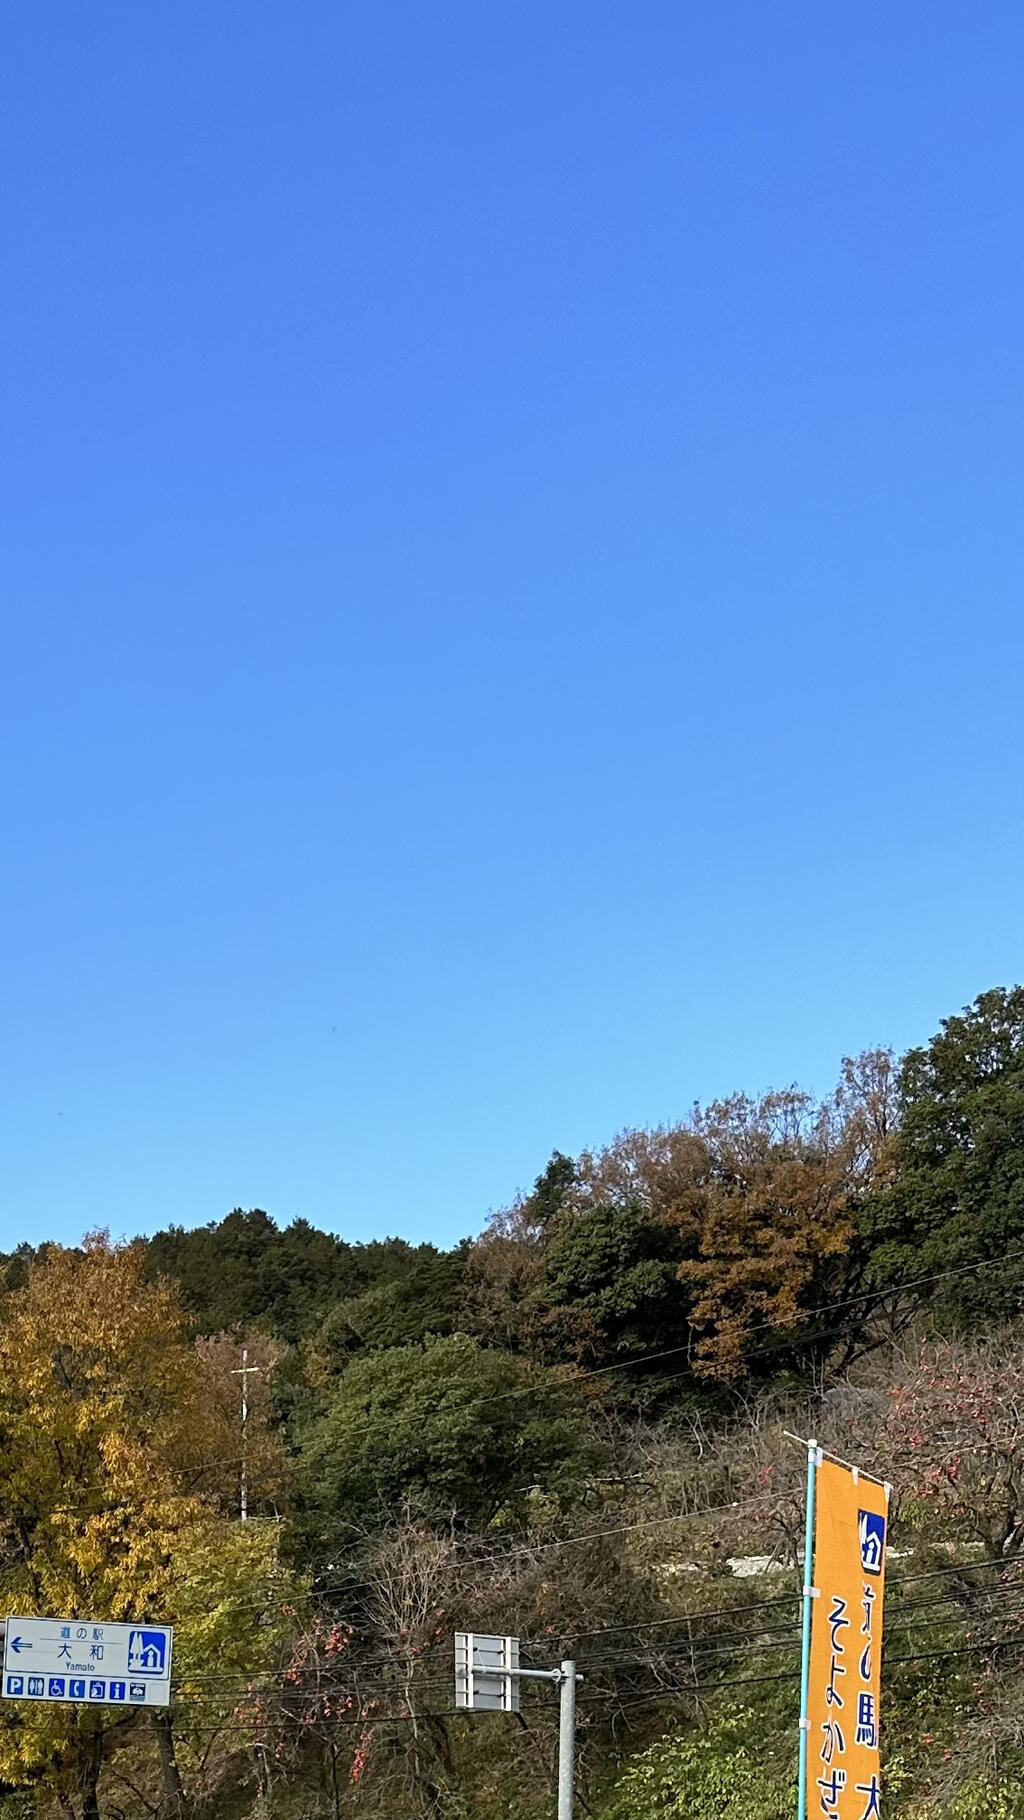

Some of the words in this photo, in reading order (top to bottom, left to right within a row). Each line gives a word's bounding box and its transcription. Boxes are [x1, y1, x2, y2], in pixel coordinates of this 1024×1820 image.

[60, 1626, 104, 1641] 道の駅
[57, 1643, 104, 1661] 大和
[65, 1661, 96, 1672] Yamato
